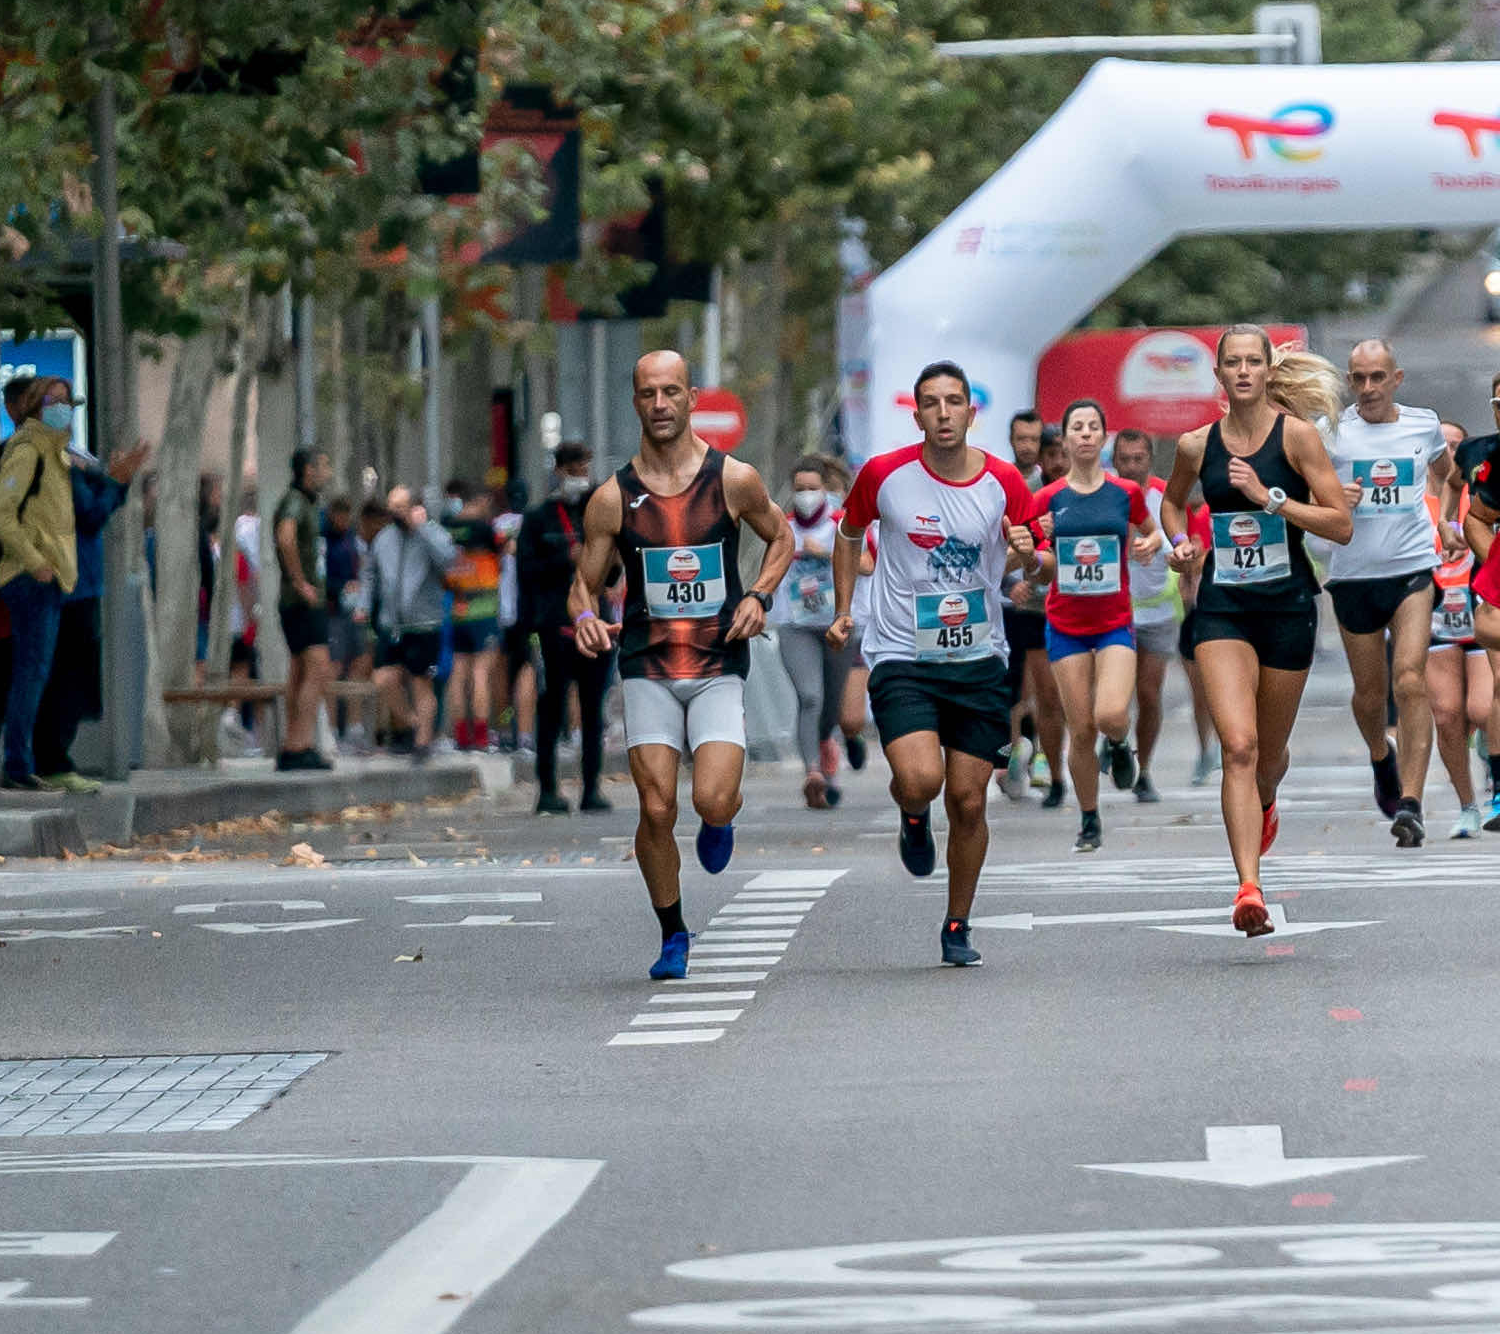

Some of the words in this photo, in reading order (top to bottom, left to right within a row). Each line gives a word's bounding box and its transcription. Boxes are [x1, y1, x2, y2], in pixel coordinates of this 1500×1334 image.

[1371, 485, 1400, 504] 431
[1233, 546, 1266, 569] 421
[1074, 565, 1105, 583] 445
[667, 581, 707, 606] 430
[1443, 610, 1471, 628] 454
[936, 624, 973, 649] 455
